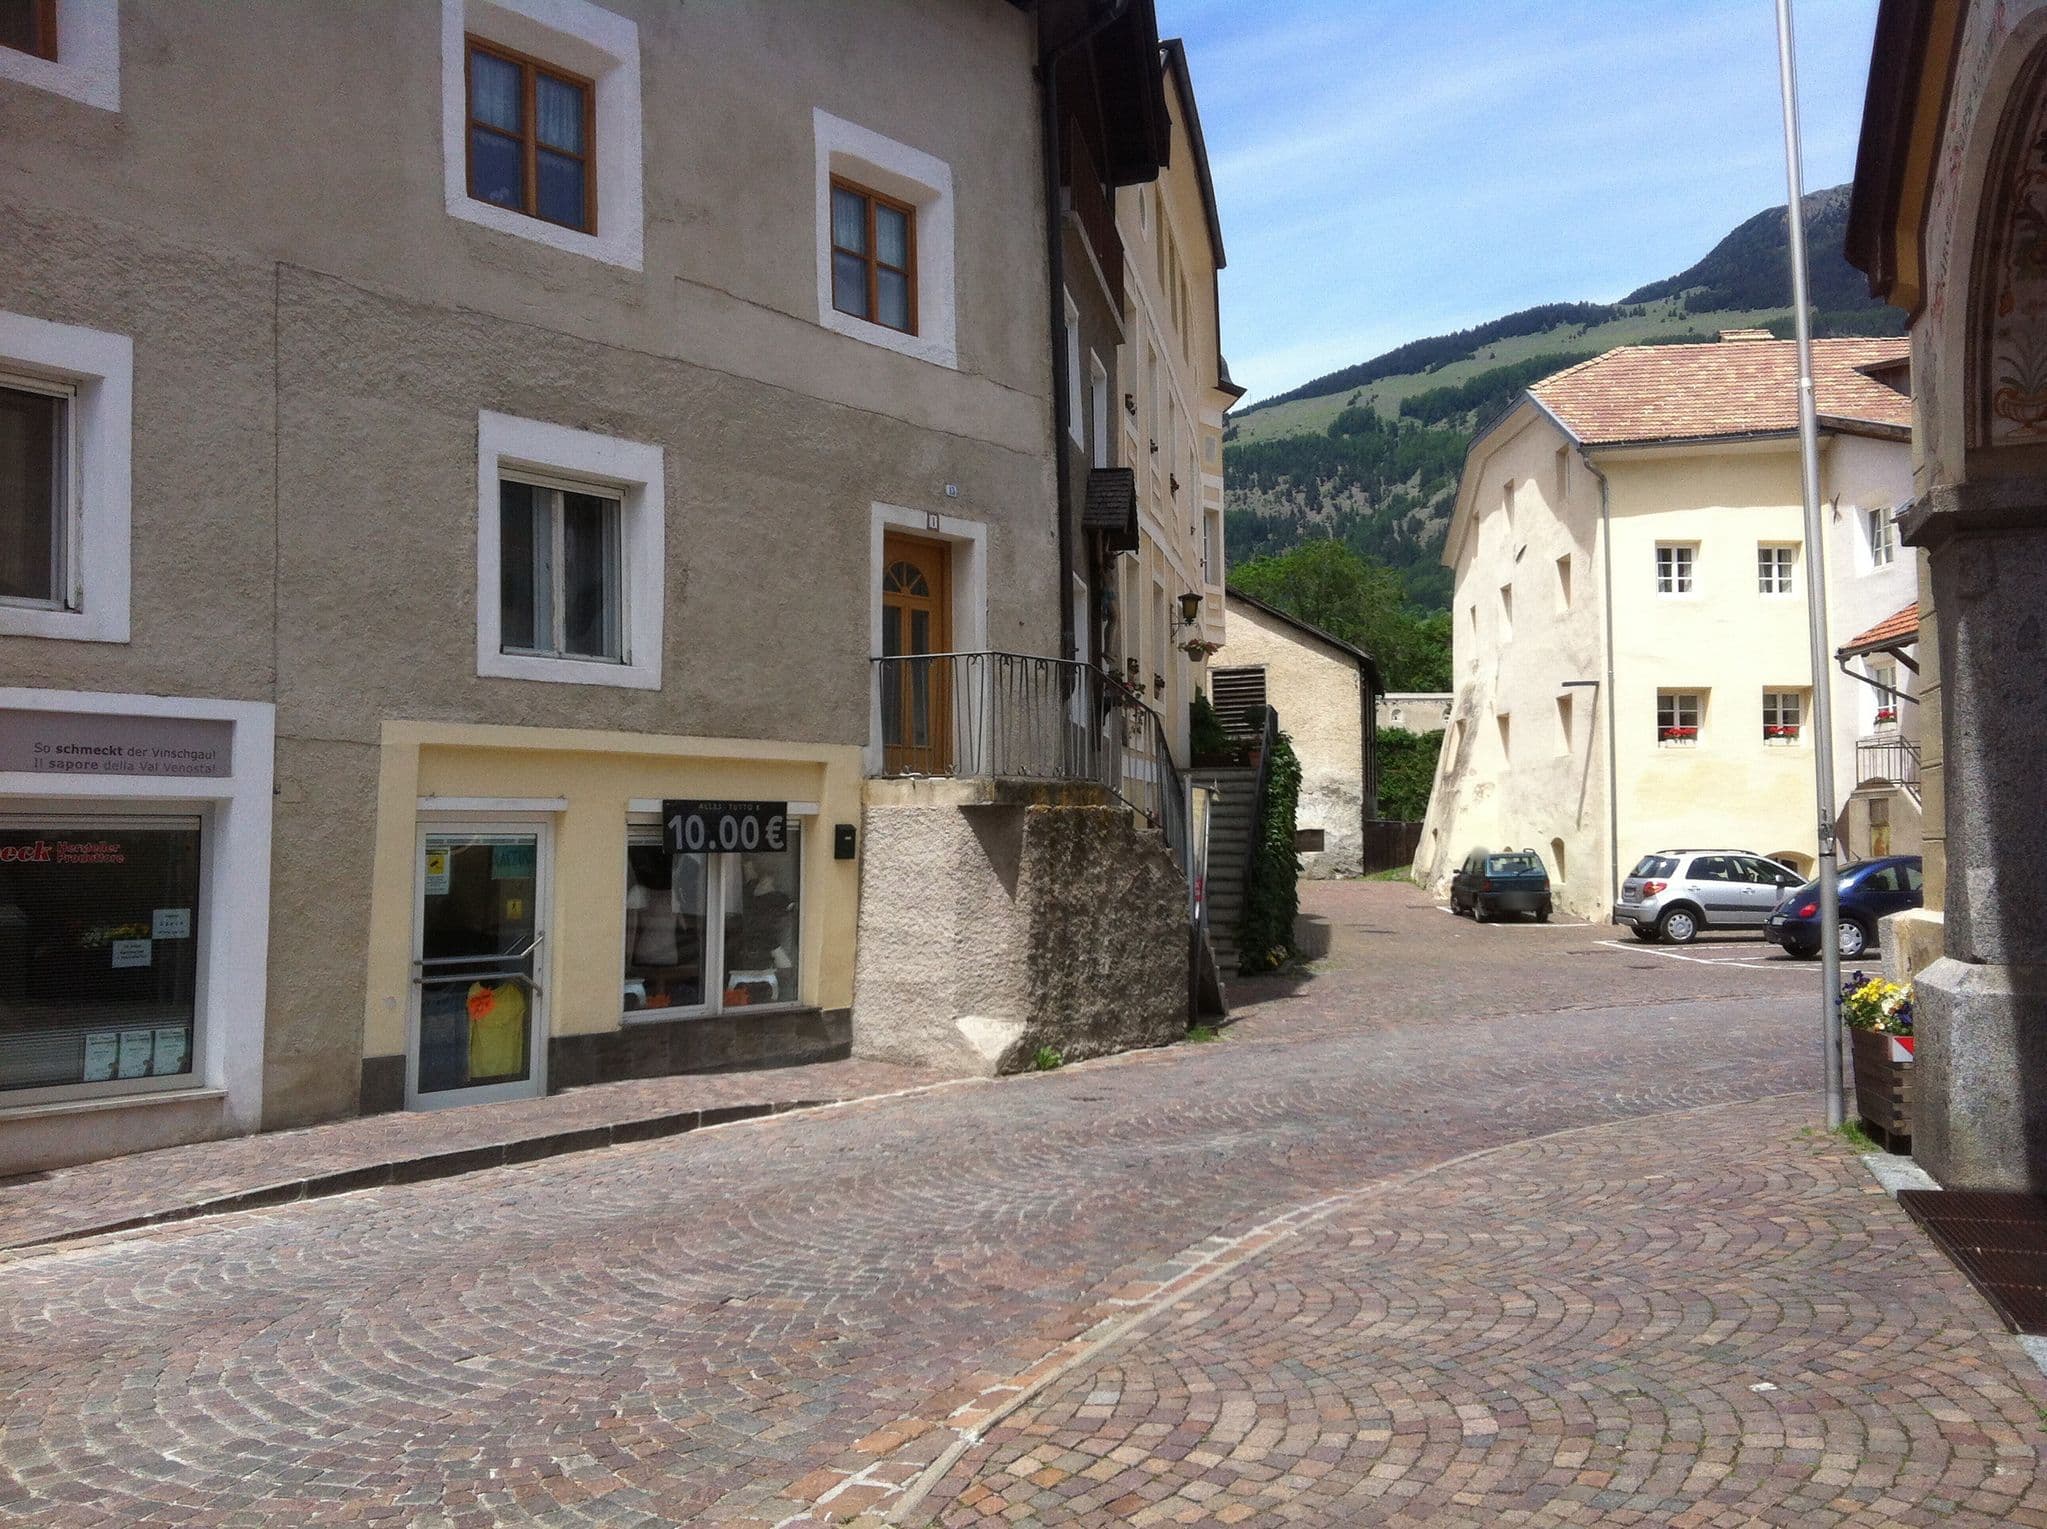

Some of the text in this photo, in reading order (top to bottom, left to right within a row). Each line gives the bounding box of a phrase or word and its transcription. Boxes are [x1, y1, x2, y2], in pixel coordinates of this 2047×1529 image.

[34, 742, 51, 753] So
[55, 744, 123, 756] schmeckt
[127, 746, 148, 757] der
[48, 759, 99, 771] sapore
[104, 760, 134, 771] della
[139, 761, 158, 771] Val
